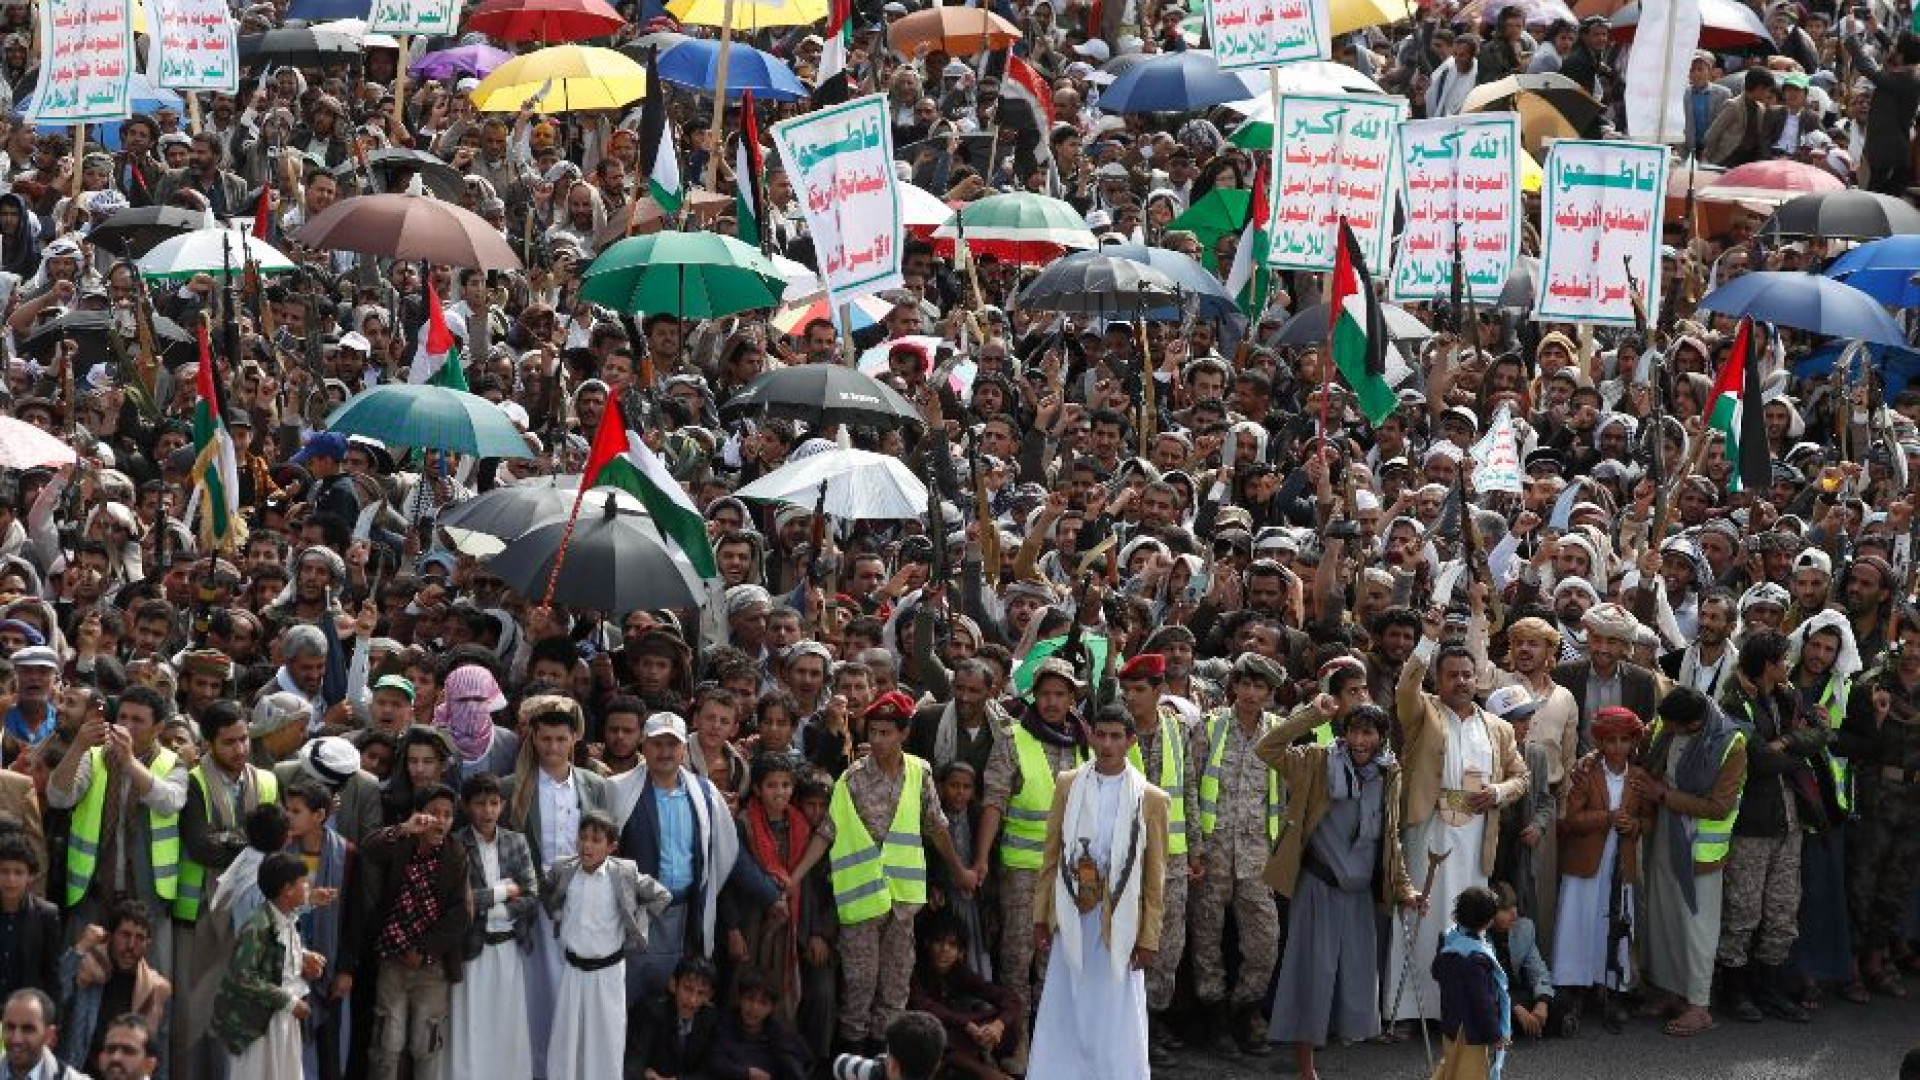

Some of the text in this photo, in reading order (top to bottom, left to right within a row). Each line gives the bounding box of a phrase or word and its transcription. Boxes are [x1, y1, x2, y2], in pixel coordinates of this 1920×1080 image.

[1350, 112, 1390, 140] الله
[1469, 132, 1508, 160] الله
[1341, 151, 1386, 172] الموت
[1462, 172, 1509, 194] الموت
[1556, 155, 1656, 193] قاطعوا
[1338, 181, 1383, 200] الموت
[1462, 202, 1509, 224] الموت
